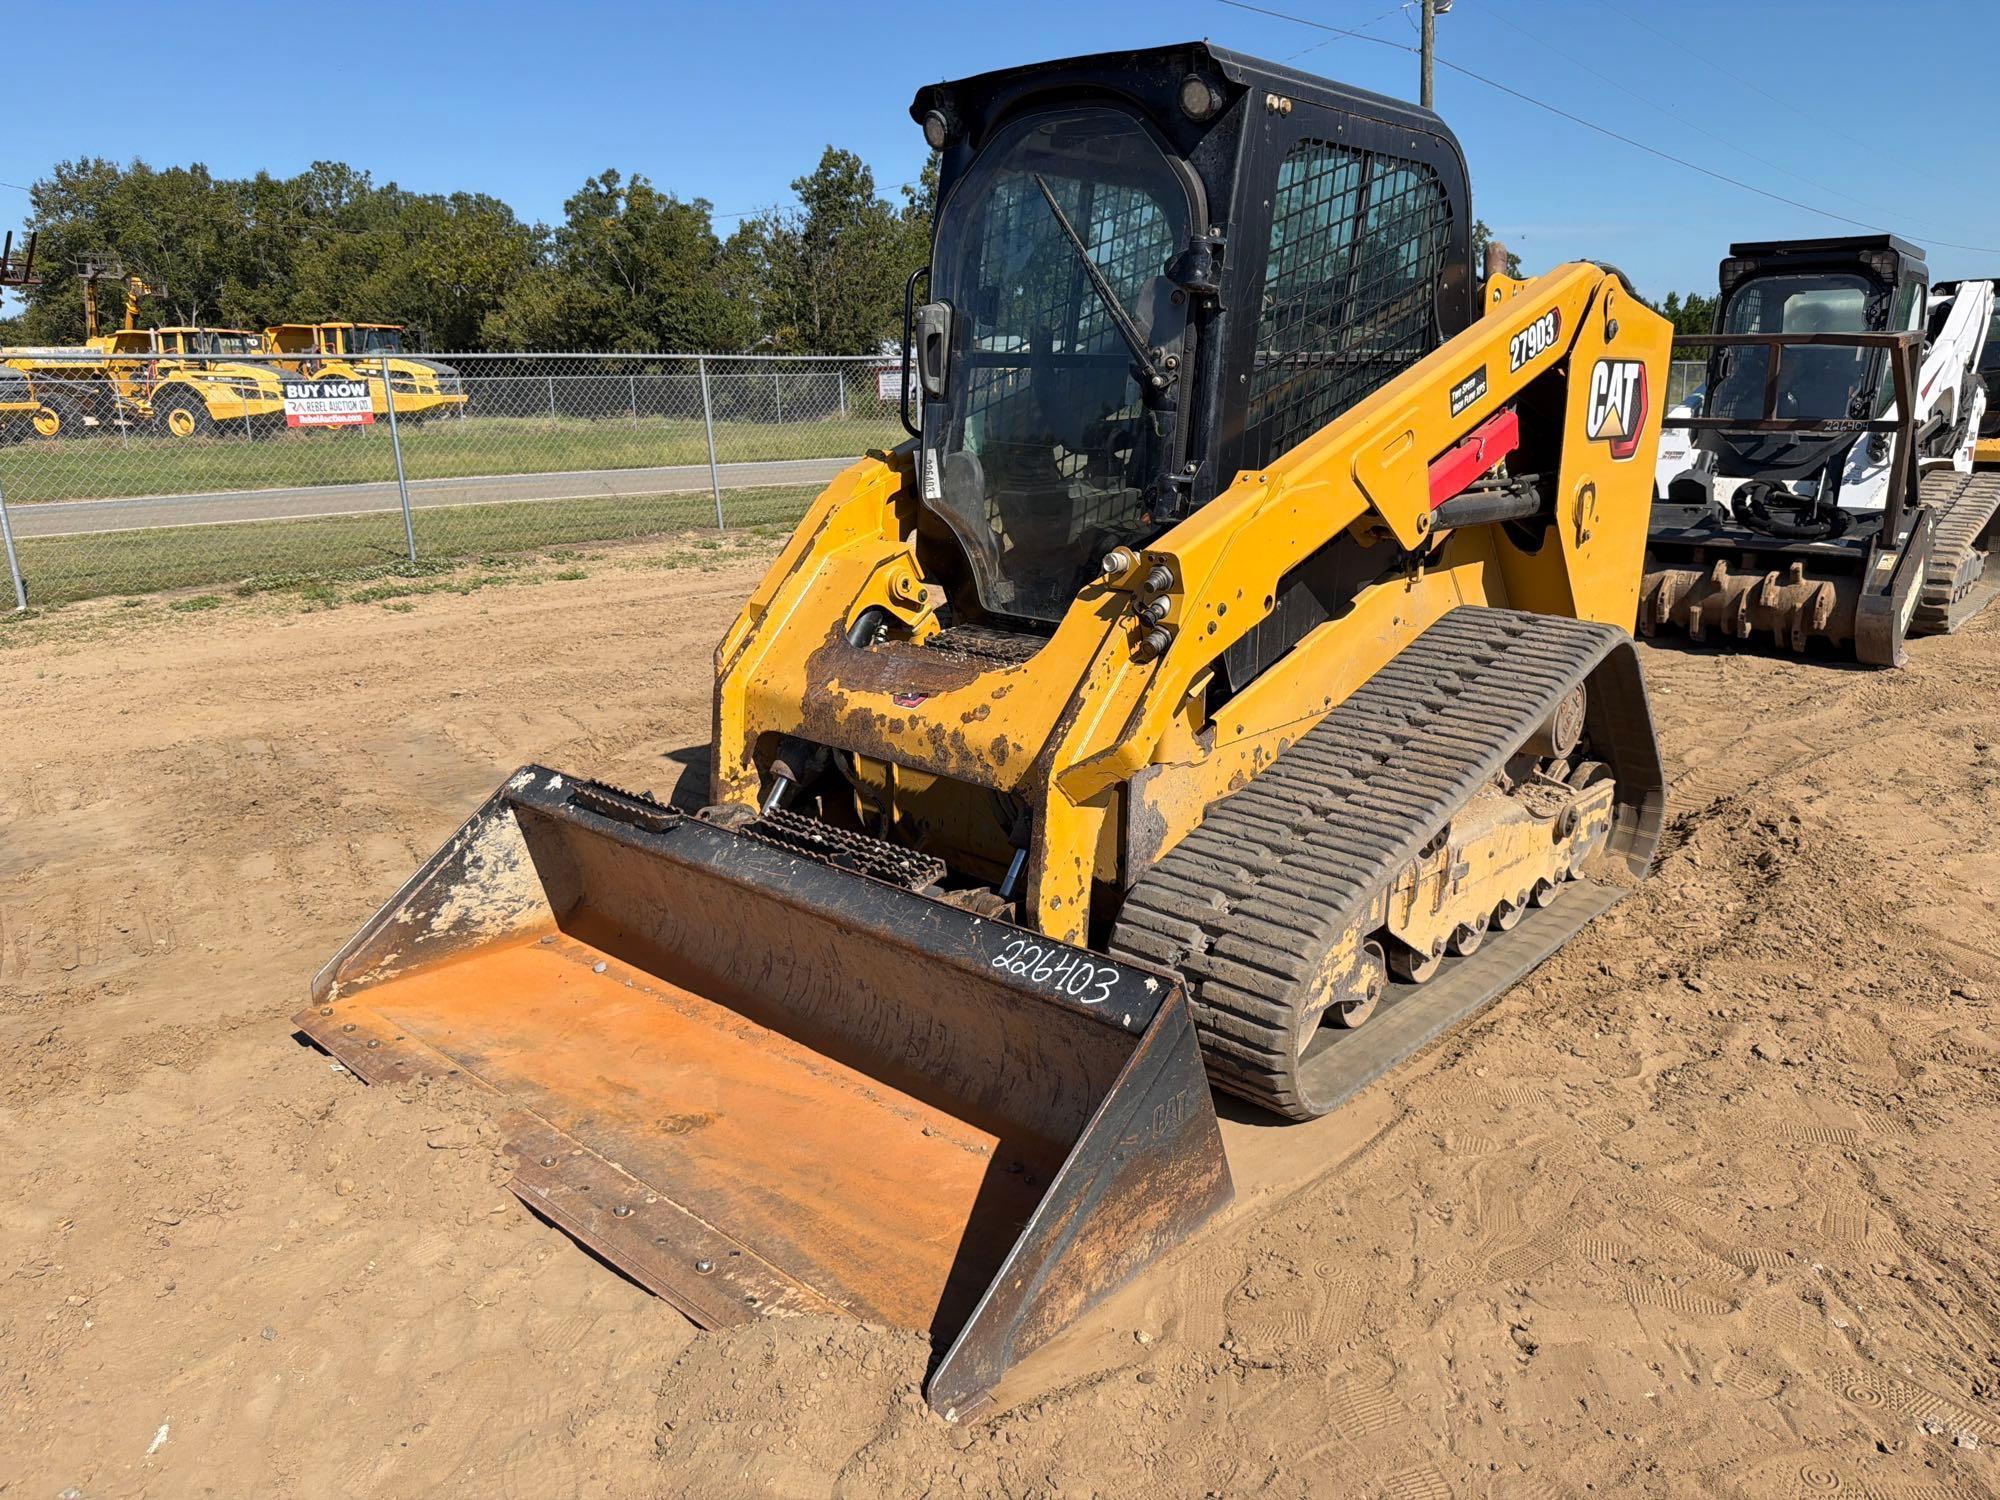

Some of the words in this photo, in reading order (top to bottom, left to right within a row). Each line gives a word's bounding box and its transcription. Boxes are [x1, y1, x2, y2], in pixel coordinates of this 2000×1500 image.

[1510, 312, 1555, 372] 279D3
[286, 384, 320, 398] BUY
[323, 383, 365, 397] NOW
[306, 401, 328, 413] REBEL
[329, 400, 358, 412] AUCTION
[359, 399, 371, 410] CO.
[1588, 360, 1640, 438] CAT
[1823, 420, 1869, 431] 226404
[992, 940, 1120, 1004] 226403
[1152, 1089, 1187, 1139] CAT
